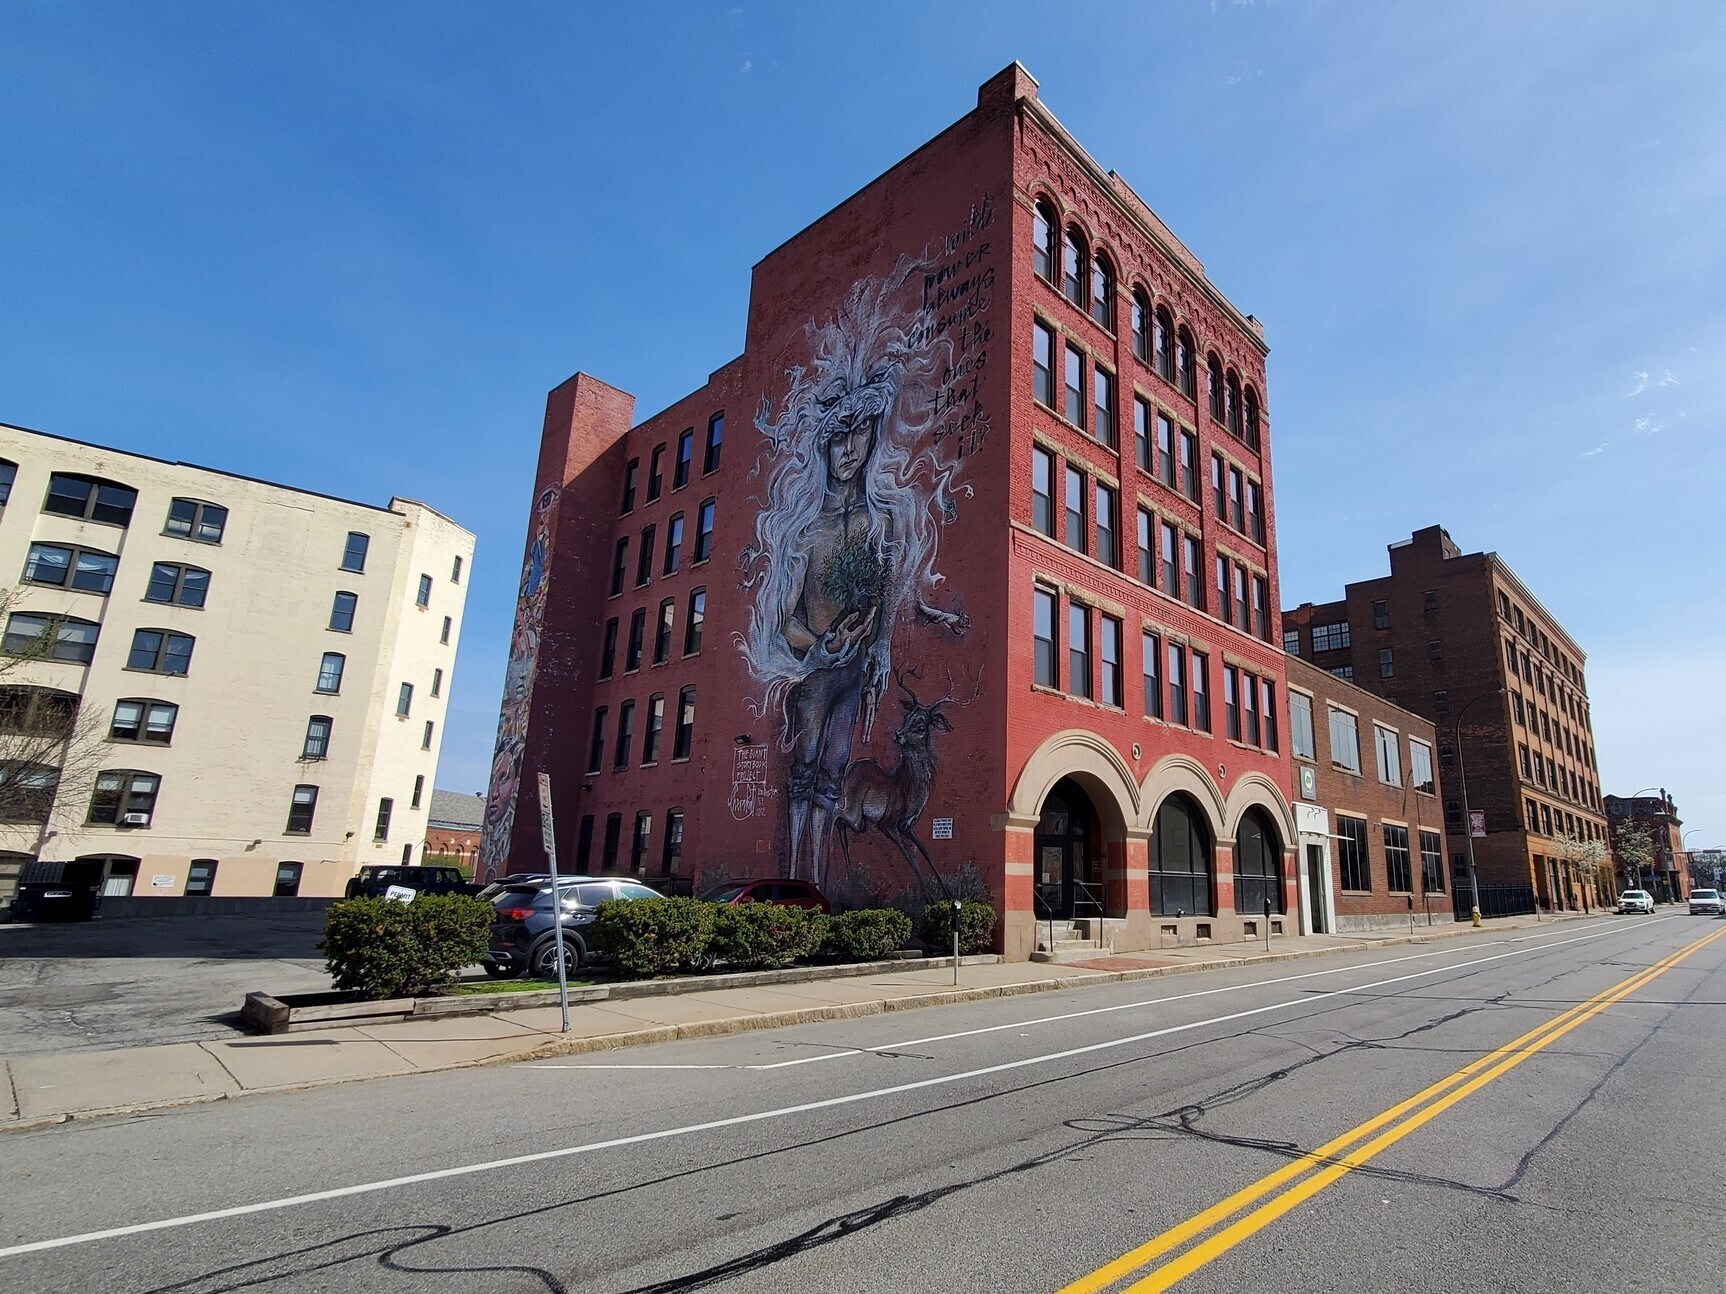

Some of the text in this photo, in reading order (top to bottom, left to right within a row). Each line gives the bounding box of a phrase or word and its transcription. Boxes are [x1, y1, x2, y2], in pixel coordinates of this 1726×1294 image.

[958, 321, 994, 352] the
[942, 350, 987, 386] ones
[926, 374, 978, 415] that
[933, 400, 991, 445] seek
[390, 890, 411, 899] PERMIT
